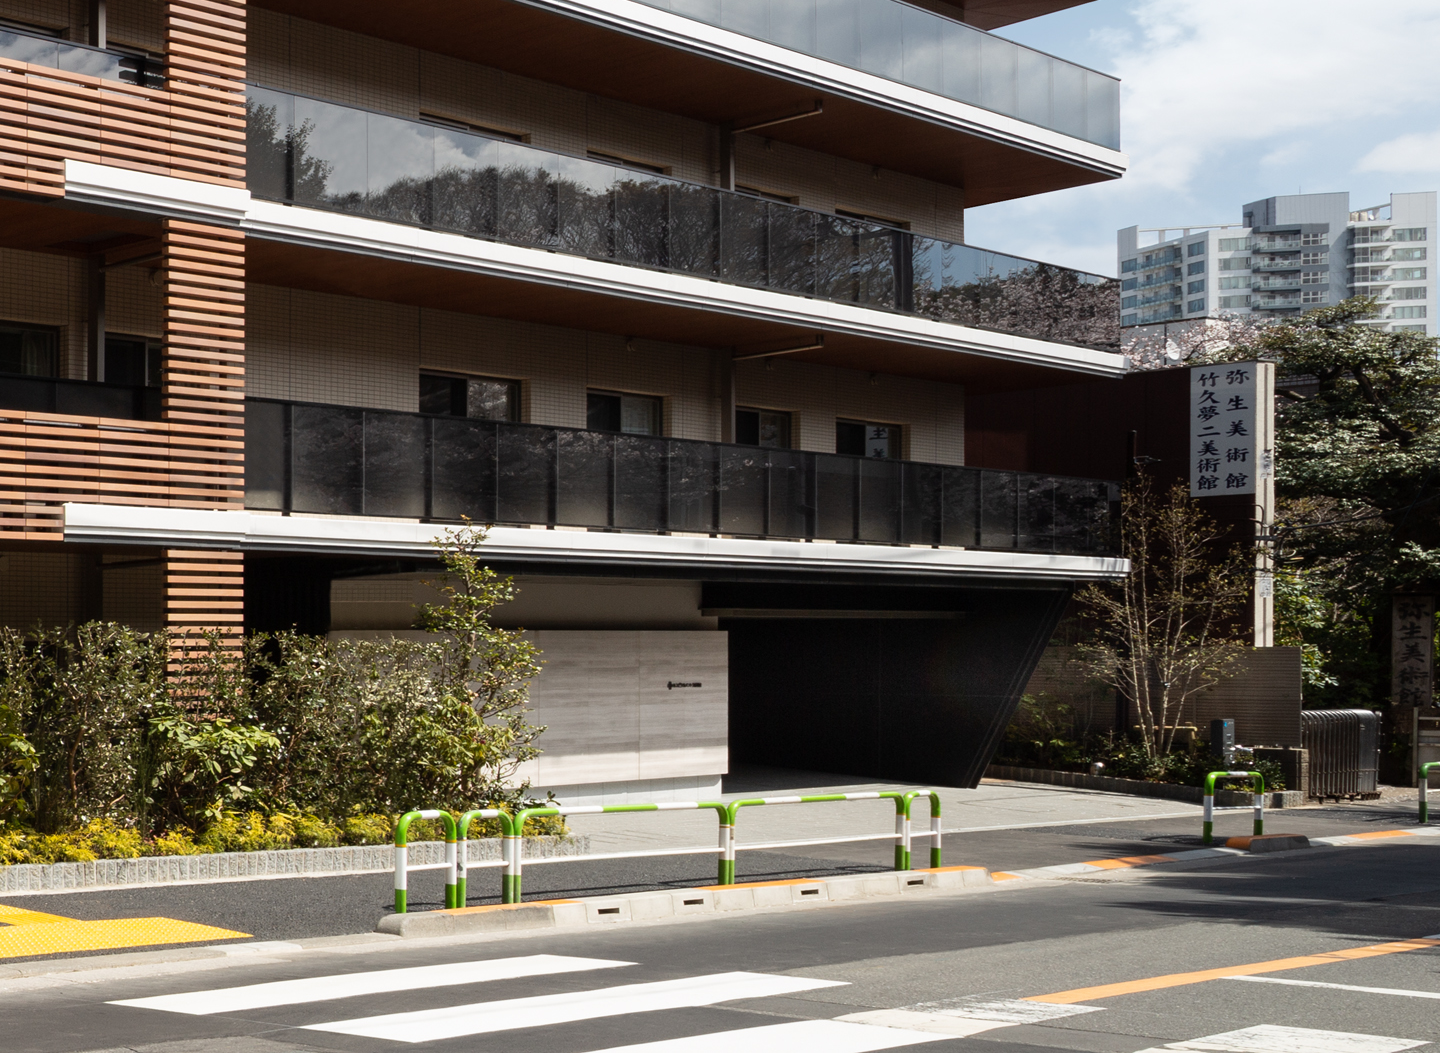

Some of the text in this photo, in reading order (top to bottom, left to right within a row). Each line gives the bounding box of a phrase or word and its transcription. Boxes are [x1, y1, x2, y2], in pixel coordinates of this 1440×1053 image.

[1197, 372, 1221, 490] 竹久夢二美術館
[1225, 369, 1250, 489] 弥生美術館
[1396, 601, 1430, 706] 弥生美術館
